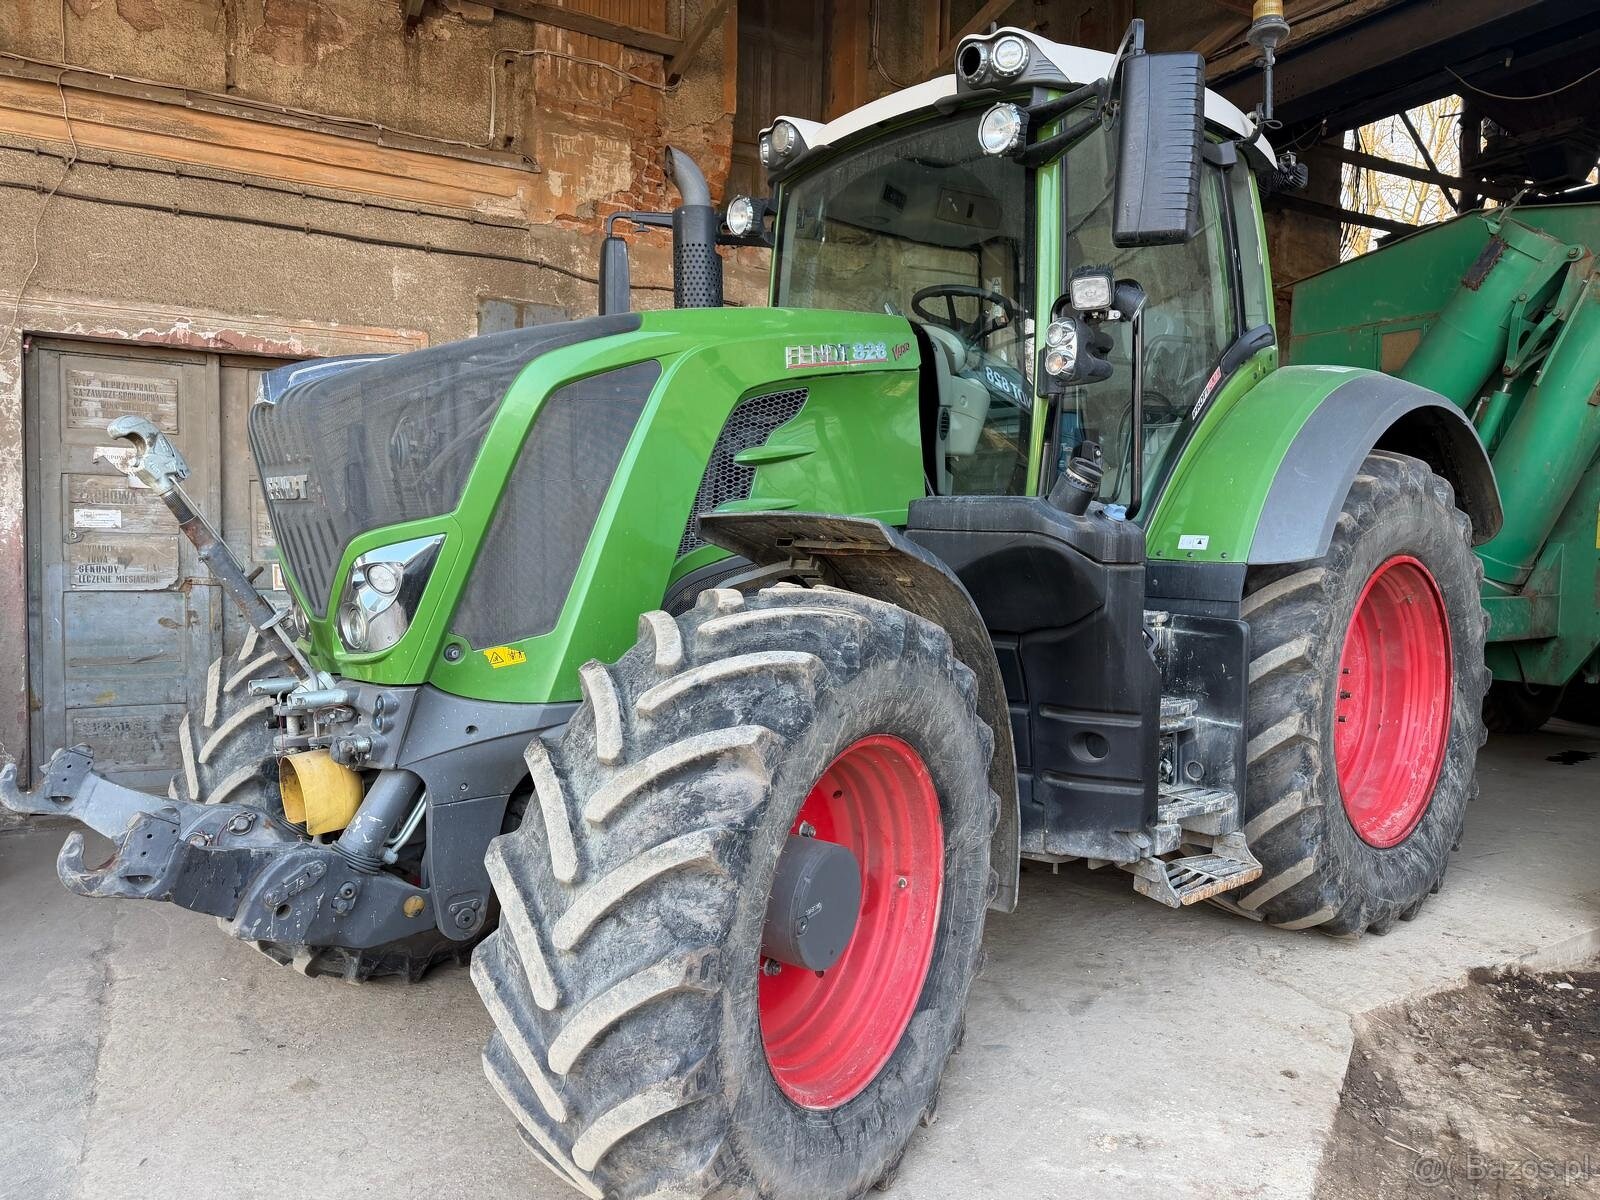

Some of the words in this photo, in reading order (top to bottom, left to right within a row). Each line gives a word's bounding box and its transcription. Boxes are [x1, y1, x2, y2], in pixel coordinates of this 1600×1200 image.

[785, 343, 847, 367] FENDT
[853, 341, 887, 360] 828
[78, 564, 119, 574] SEKUNDY
[78, 574, 112, 584] LECZENIE
